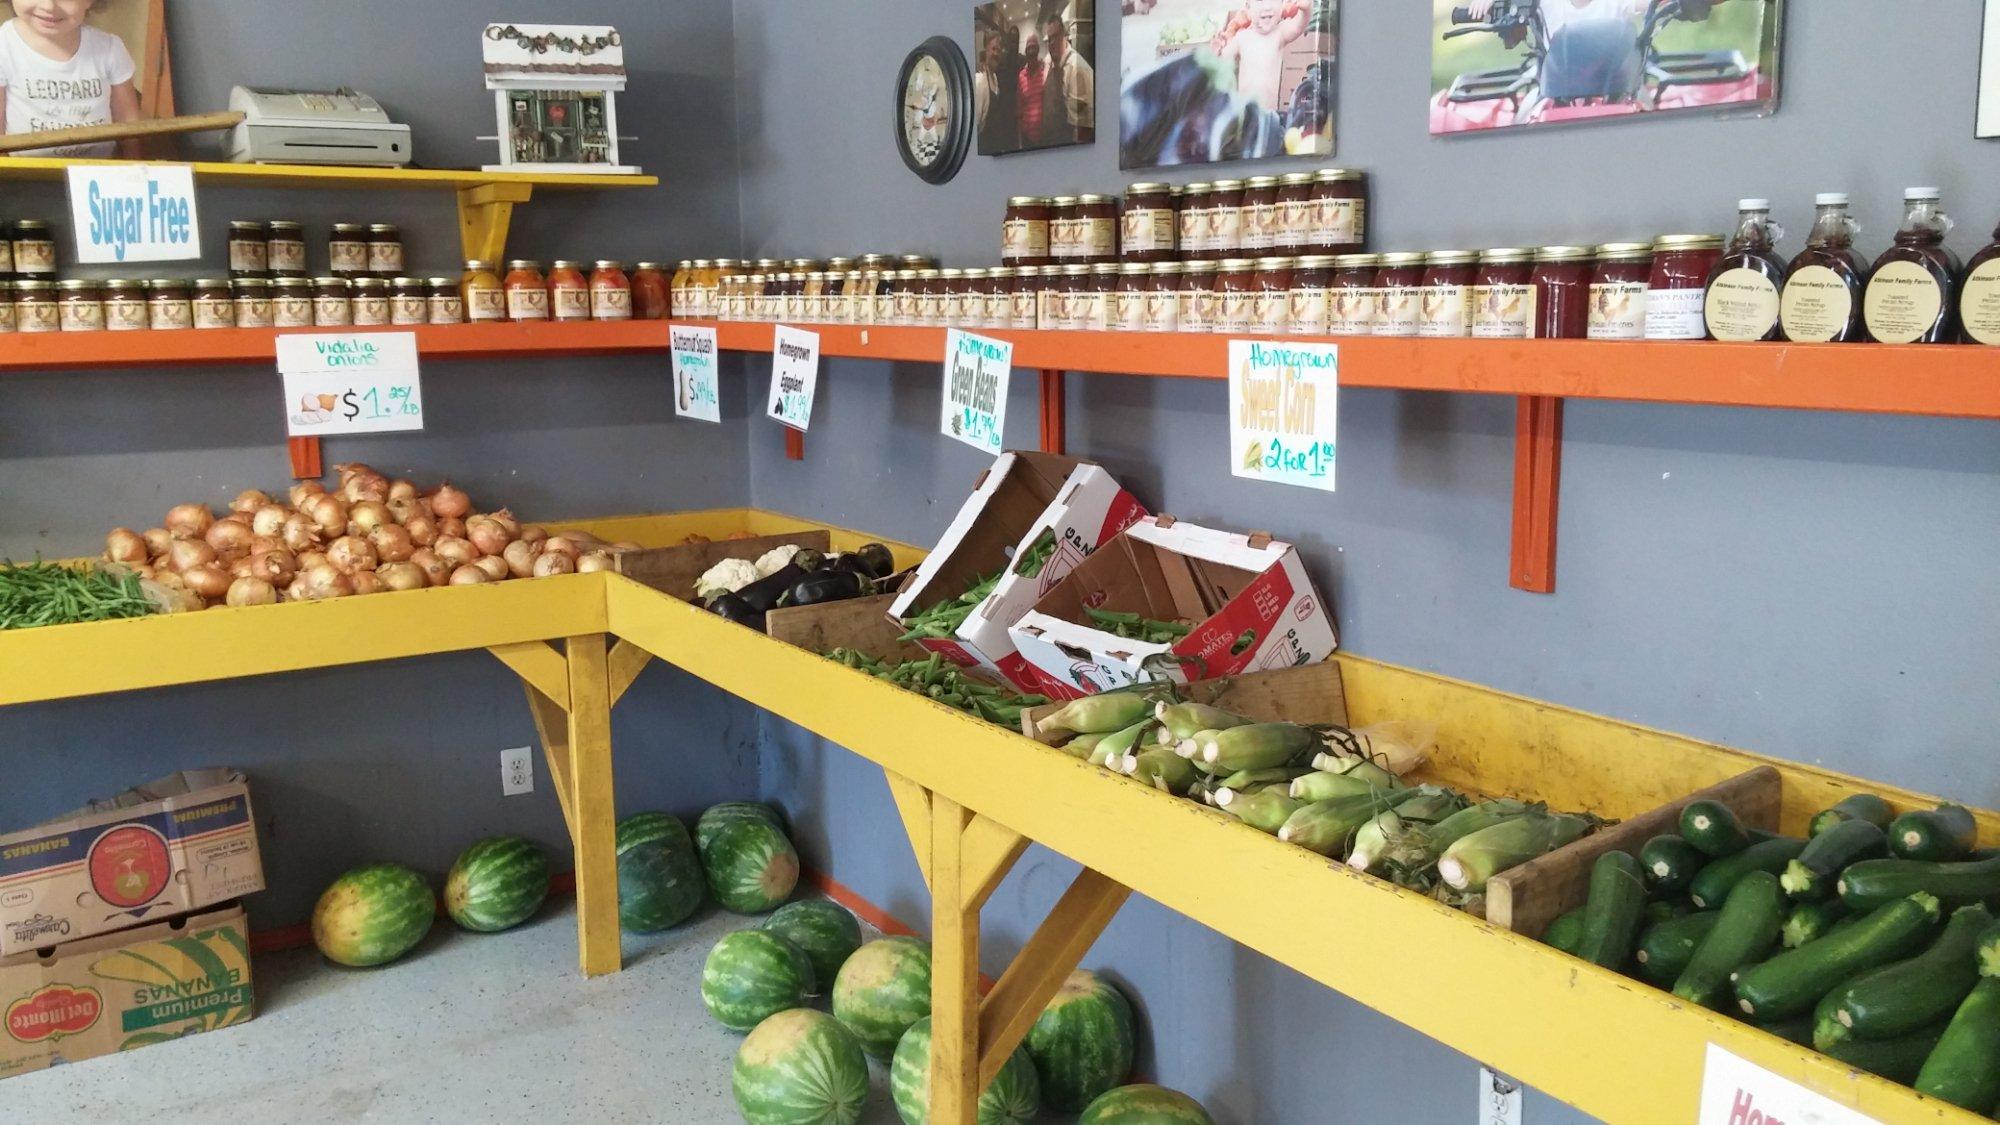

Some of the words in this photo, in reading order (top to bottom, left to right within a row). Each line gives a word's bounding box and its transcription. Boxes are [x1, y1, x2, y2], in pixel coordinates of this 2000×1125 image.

[26, 79, 103, 99] LEOPARD
[88, 179, 143, 261] Sugar
[147, 180, 190, 244] Free
[1400, 288, 1418, 296] Farms
[1620, 285, 1643, 293] Farms
[1738, 284, 1754, 292] Family
[1896, 277, 1913, 286] Family
[315, 339, 380, 355] Vidalia
[779, 337, 811, 363] Homegrown
[327, 352, 378, 367] onions
[1250, 343, 1338, 379] Homegrown
[780, 371, 804, 394] Eggplant
[950, 350, 974, 407] Green
[972, 356, 998, 416] Beans
[1240, 359, 1282, 434] Sweet
[1284, 364, 1317, 435] Corn
[1265, 437, 1282, 461] 2
[172, 802, 237, 824] PREMIUM
[3, 837, 71, 860] BANANAS
[133, 967, 241, 1004] BANANAS
[68, 1001, 94, 1018] Del
[151, 988, 242, 1020] Premium
[12, 1006, 68, 1029] Monte
